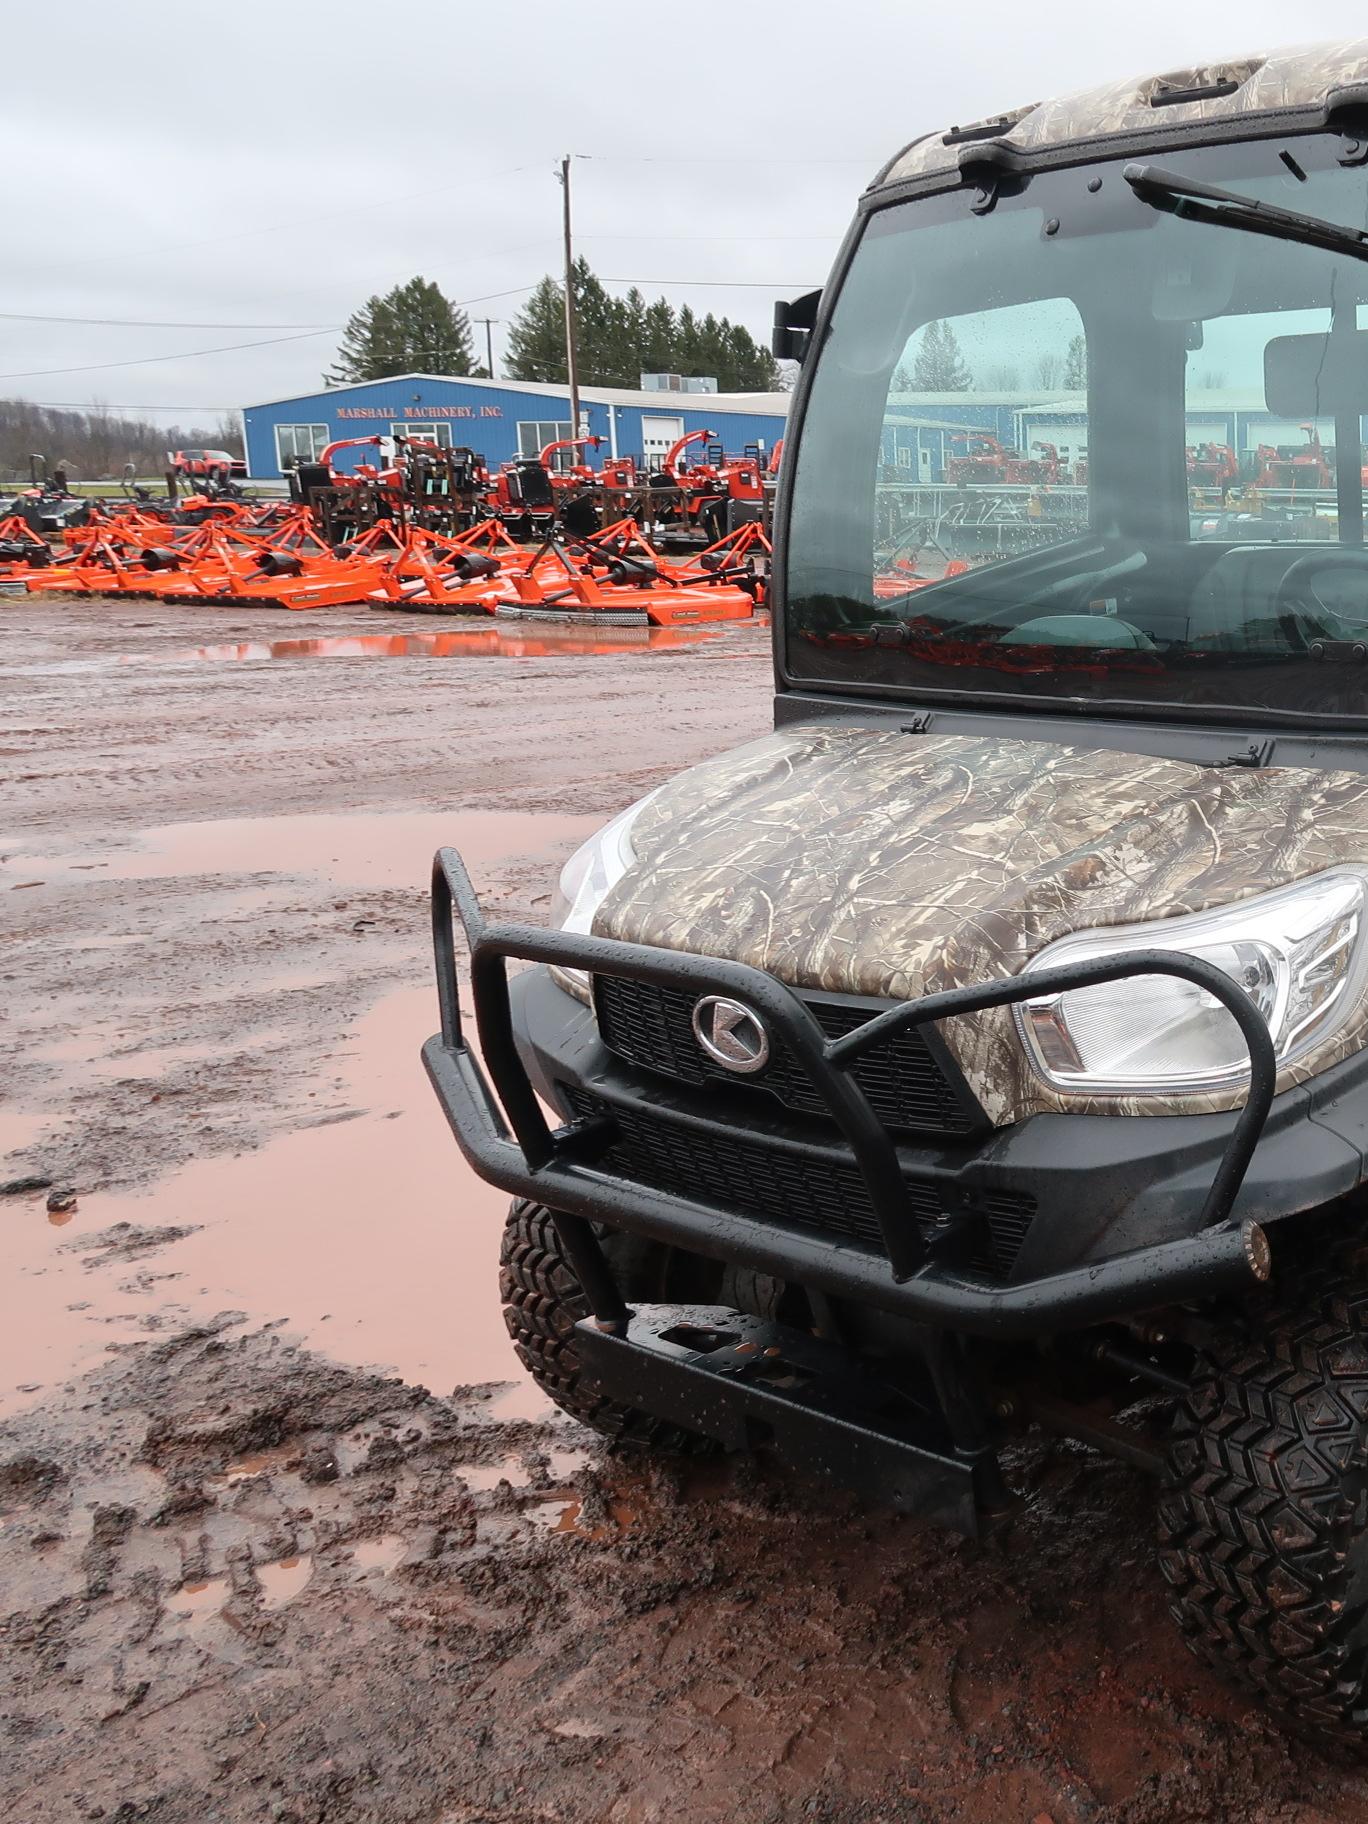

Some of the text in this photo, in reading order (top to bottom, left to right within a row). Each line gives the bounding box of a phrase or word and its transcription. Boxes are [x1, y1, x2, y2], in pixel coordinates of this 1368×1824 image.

[336, 406, 503, 419] MARSHALL MACHINERY, INC.
